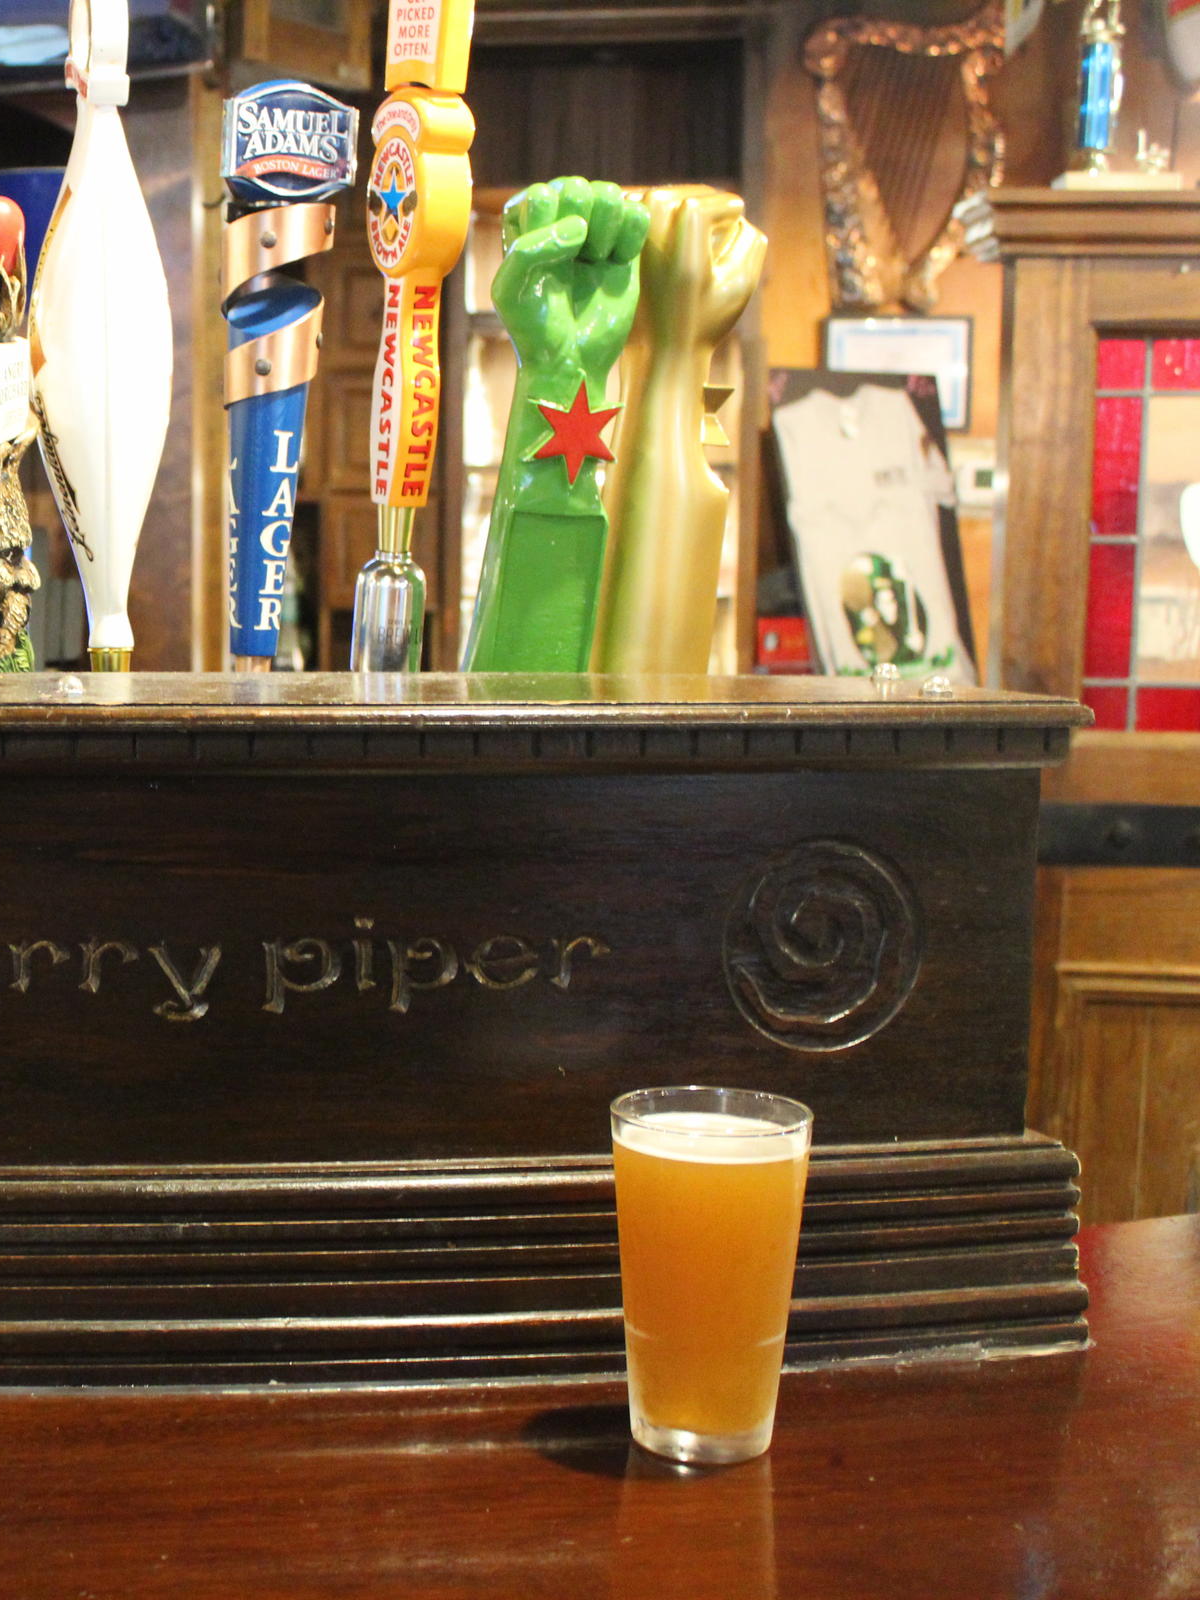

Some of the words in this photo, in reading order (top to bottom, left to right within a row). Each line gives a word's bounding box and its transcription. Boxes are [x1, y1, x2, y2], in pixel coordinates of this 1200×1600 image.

[396, 7, 435, 21] PICKED
[398, 24, 431, 39] MORE
[394, 42, 431, 56] OFTEN.
[237, 102, 348, 138] SAMUEL
[242, 130, 339, 164] ADAMS
[373, 142, 413, 188] NEWCASTLE
[253, 160, 300, 175] BOSTON
[302, 163, 337, 178] LAGER
[371, 220, 398, 263] BROWN
[398, 220, 411, 253] ALE
[375, 284, 401, 496] NEWCASTLE
[401, 285, 439, 497] NEWCASTLE
[254, 430, 299, 631] LAGER
[262, 917, 611, 1014] piper
